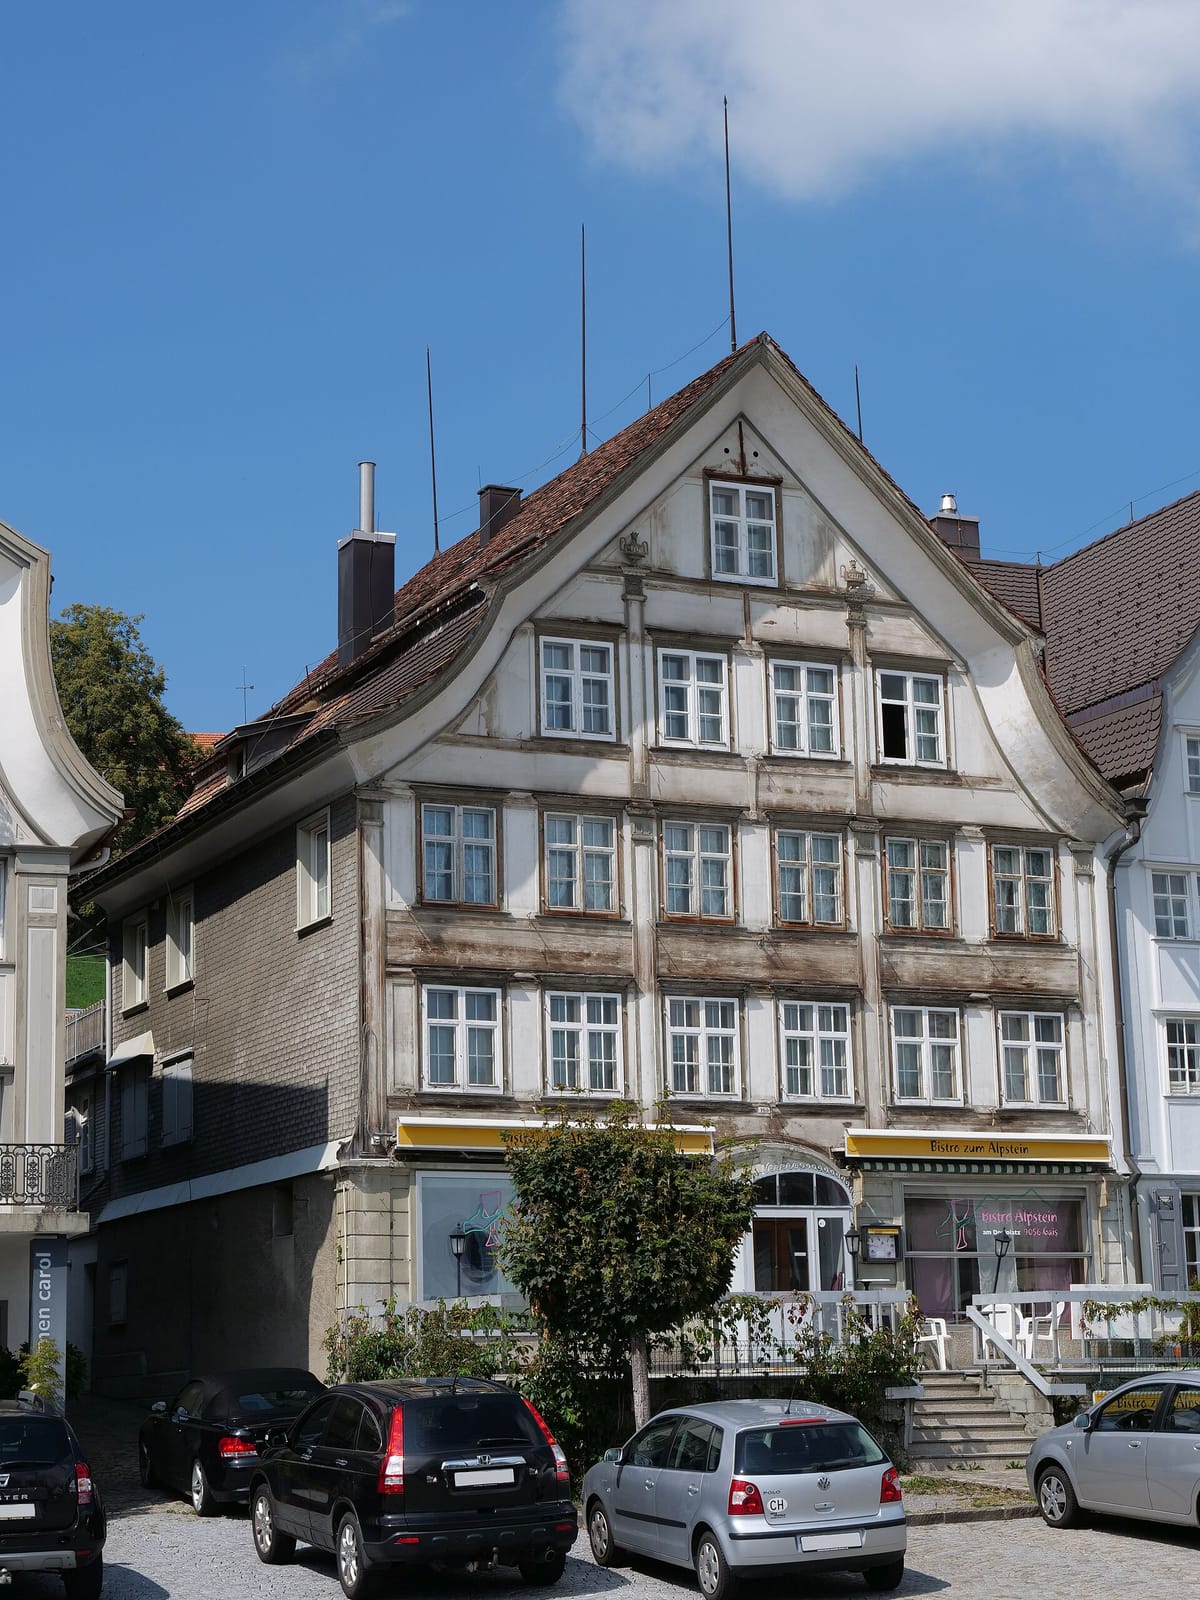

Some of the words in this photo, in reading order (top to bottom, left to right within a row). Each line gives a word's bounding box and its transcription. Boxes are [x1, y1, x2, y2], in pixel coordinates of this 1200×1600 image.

[930, 1140, 960, 1153] Bistro
[963, 1144, 985, 1153] zum
[988, 1141, 1029, 1158] Alpstein
[982, 1206, 1012, 1222] Bistro
[1014, 1209, 1058, 1226] Alpstein
[1023, 1228, 1041, 1237] 9056
[1042, 1226, 1058, 1237] Gais
[769, 1499, 785, 1511] CH
